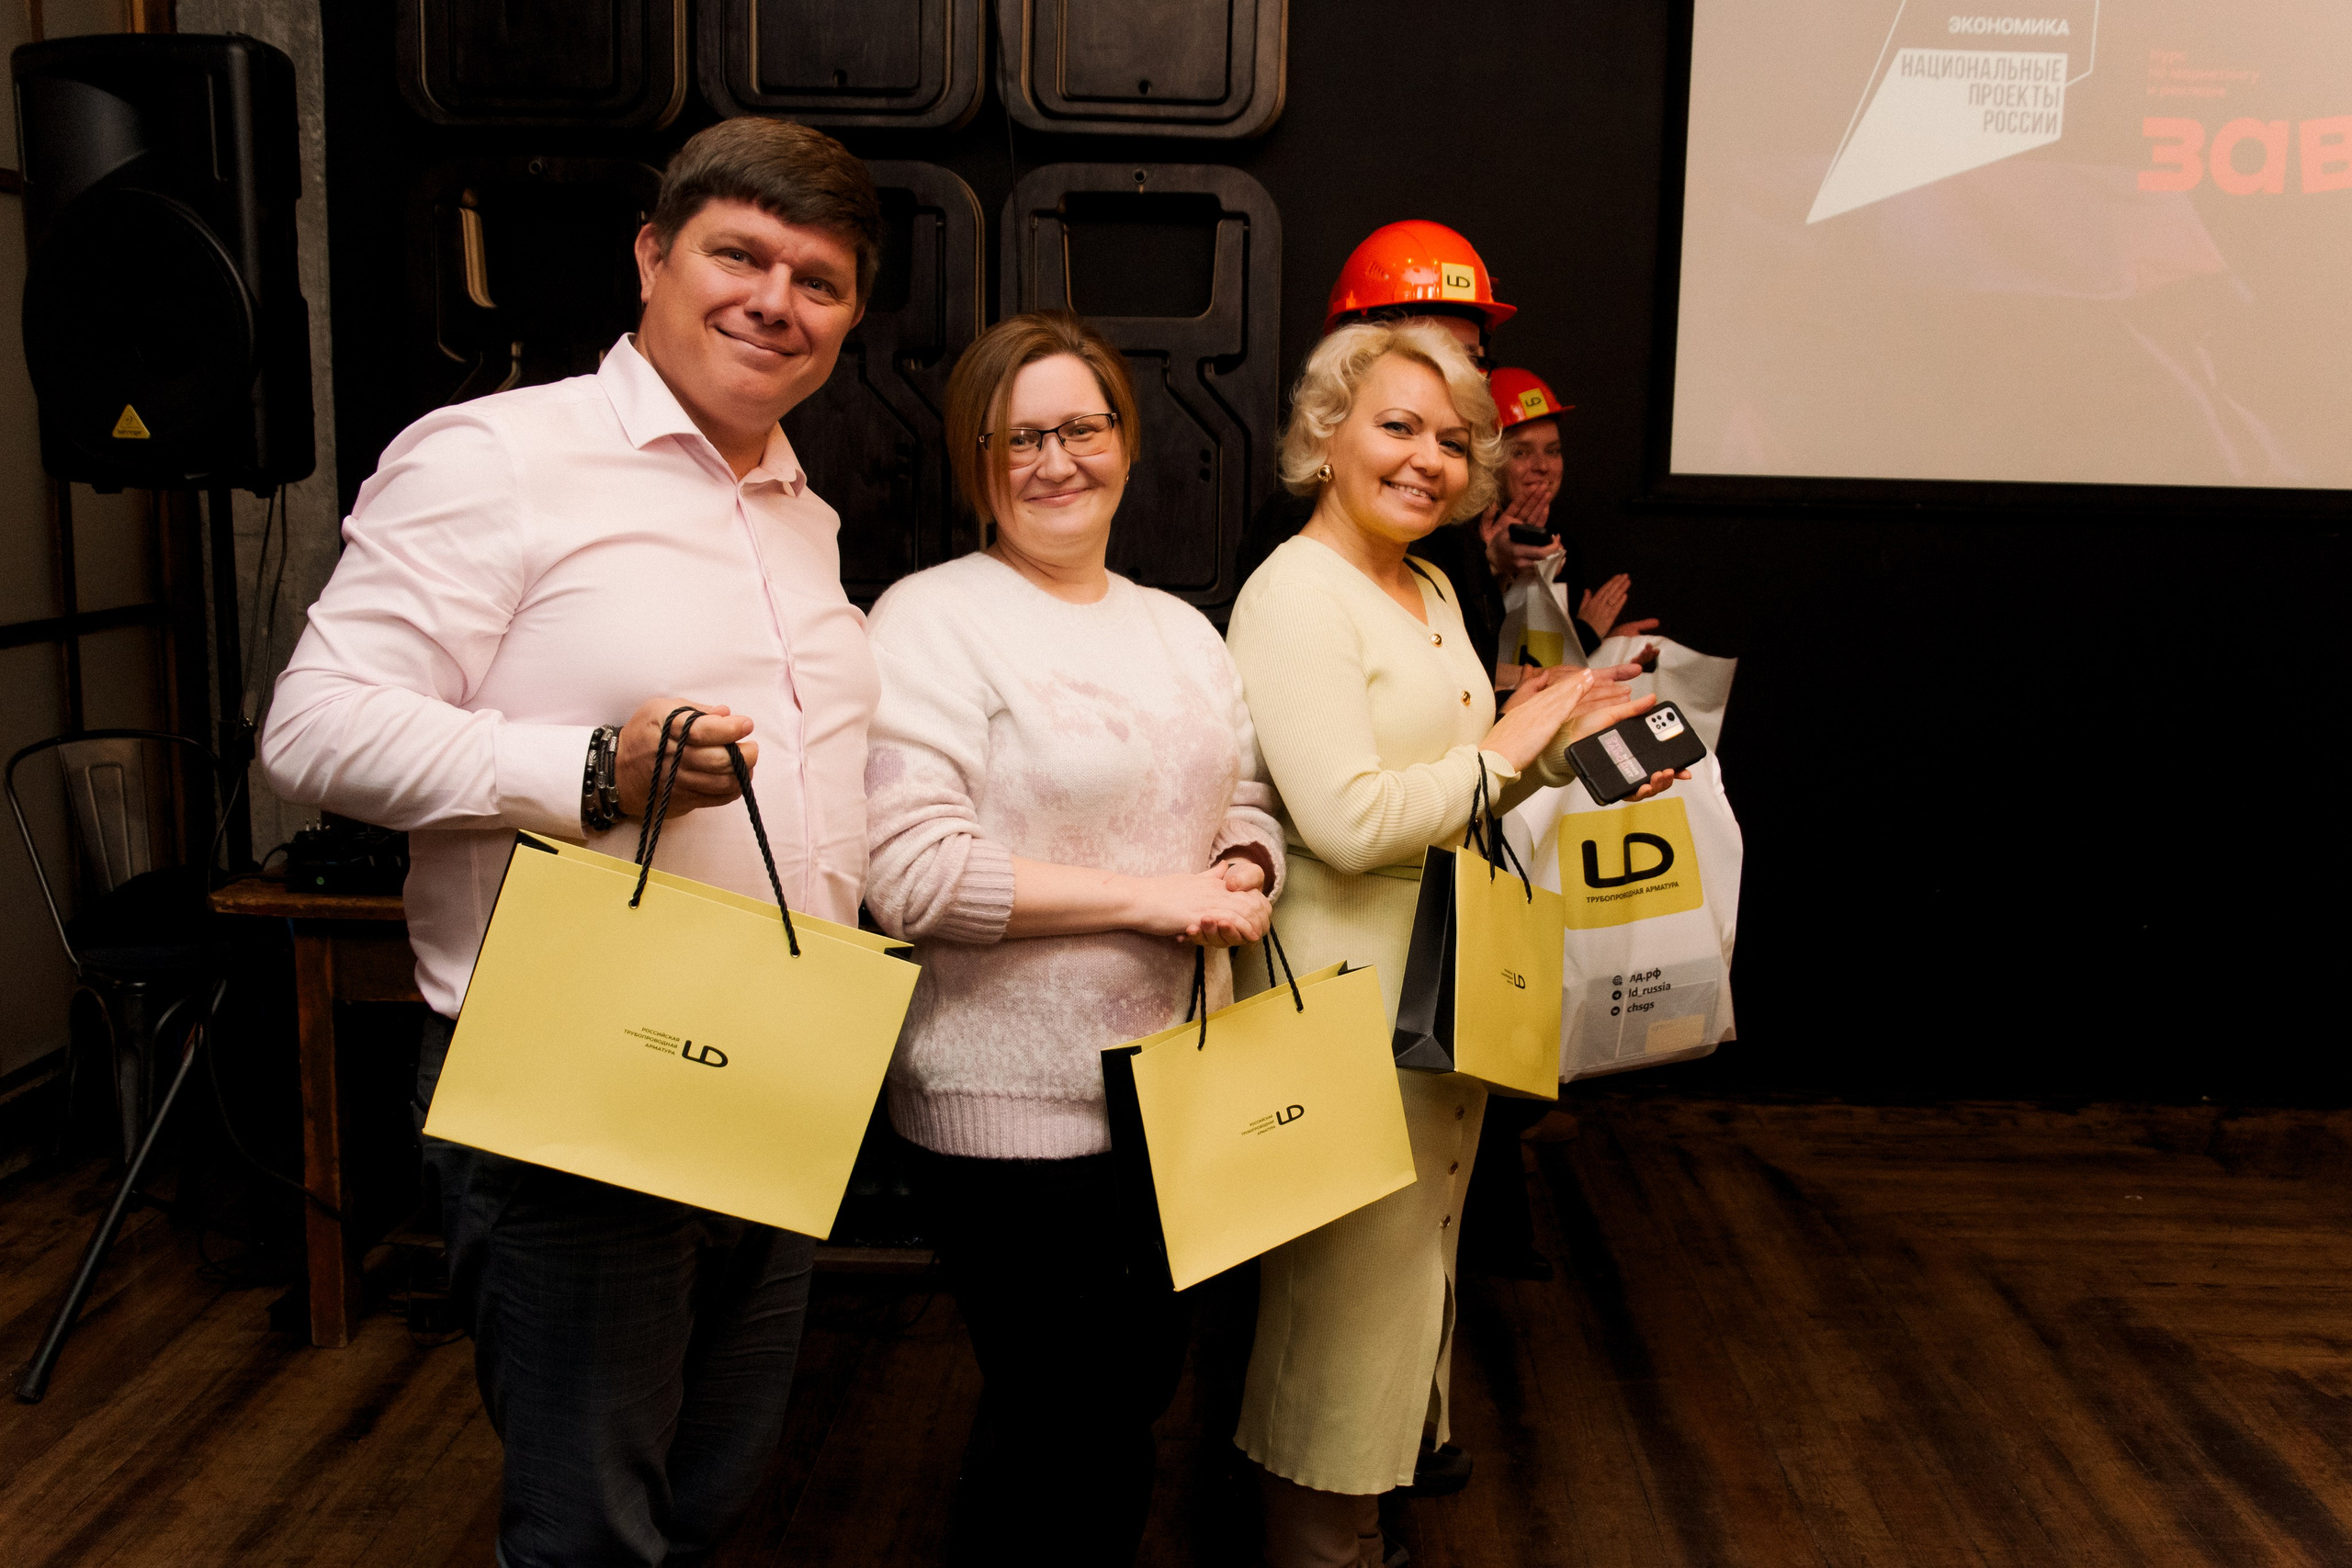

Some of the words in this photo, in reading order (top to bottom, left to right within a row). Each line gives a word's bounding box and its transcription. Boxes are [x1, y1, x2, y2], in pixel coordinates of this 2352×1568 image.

[1948, 15, 2070, 37] ЭКОНОМИКА
[1900, 53, 2064, 81] НАЦИОНАЛЬНЫЕ
[1967, 83, 2062, 108] ПРОЕКТЫ
[1983, 109, 2060, 135] РОССИИ
[1446, 274, 1471, 288] LD
[1581, 832, 1675, 889] LD
[1586, 887, 1645, 904] ТРУБОПРОВОДНАЯ
[1645, 881, 1679, 894] АРМАТУРА
[1629, 967, 1661, 983] лд.рф
[1628, 981, 1671, 998] ld_russia
[1626, 1001, 1655, 1012] chsgs
[624, 1029, 678, 1048] ТРУБОПРОВОДНАЯ
[641, 1027, 680, 1042] РОССИЙСКАЯ
[644, 1043, 675, 1055] АРМАТУРА
[681, 1039, 729, 1068] LD
[1275, 1104, 1305, 1126] LD
